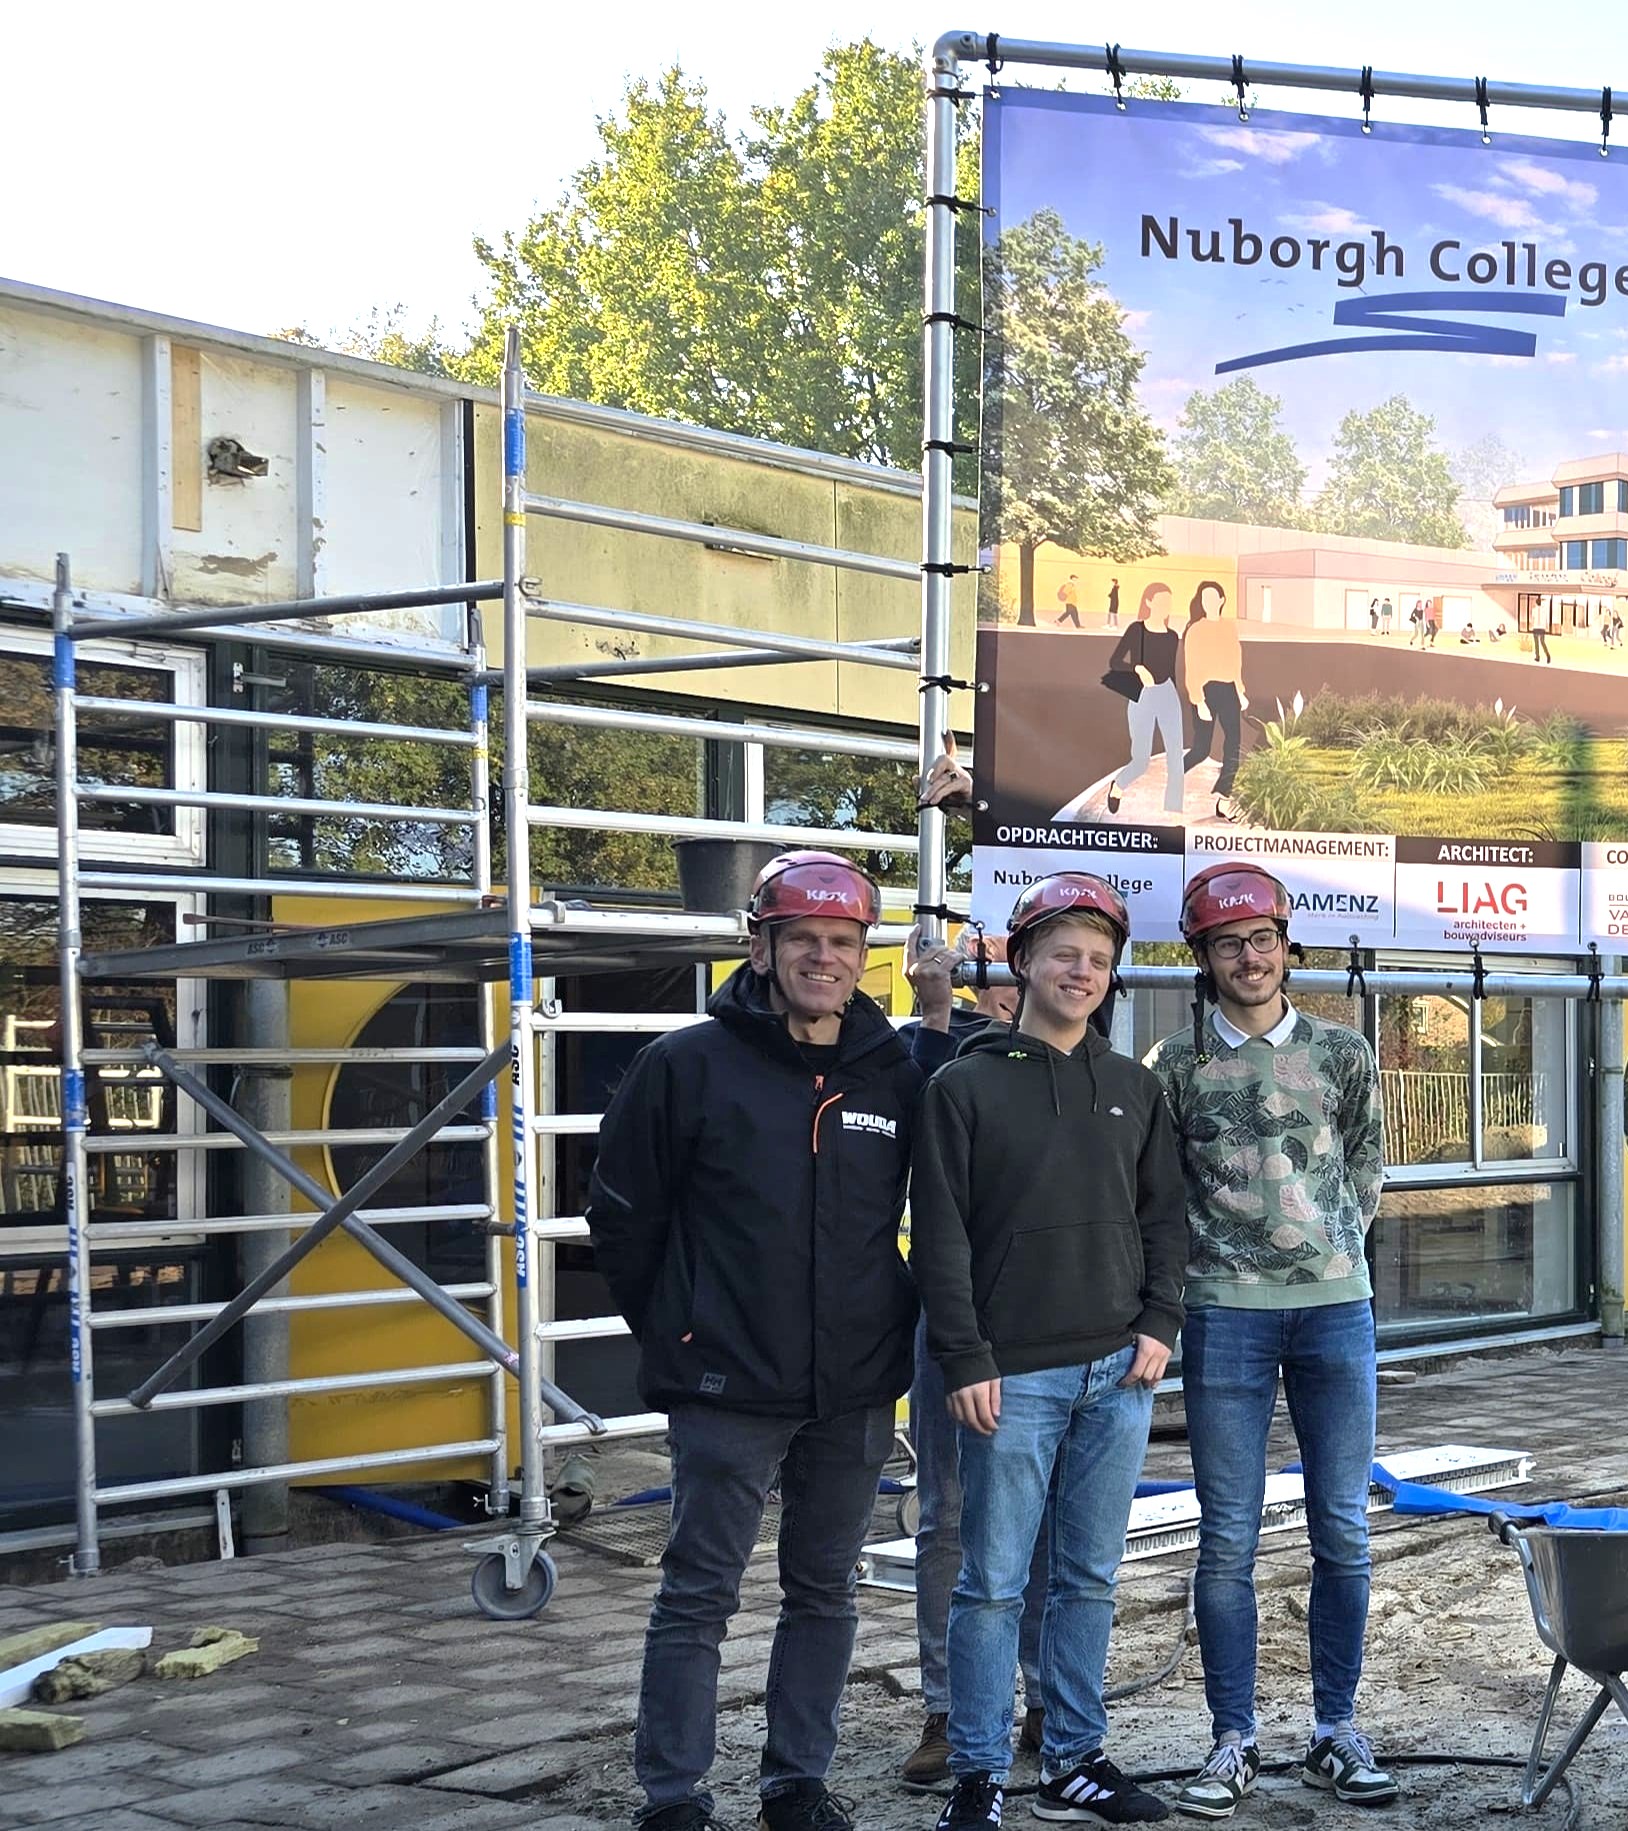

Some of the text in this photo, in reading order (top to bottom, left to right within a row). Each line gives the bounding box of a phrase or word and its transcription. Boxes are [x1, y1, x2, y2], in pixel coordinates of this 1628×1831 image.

[1140, 213, 1405, 288] Nuborgh
[996, 826, 1159, 849] OPDRACHTGEVER:
[1194, 835, 1389, 857] PROJECTMANAGEMENT:
[1437, 845, 1534, 863] ARCHITECT:
[994, 870, 1154, 894] Nubo llege
[1218, 892, 1255, 910] KASK
[1288, 892, 1379, 913] AMENZ
[1437, 881, 1528, 915] LIAG
[1443, 930, 1527, 942] bouwadviseurs
[1453, 919, 1517, 931] architecten
[841, 1110, 897, 1134] WOUDA
